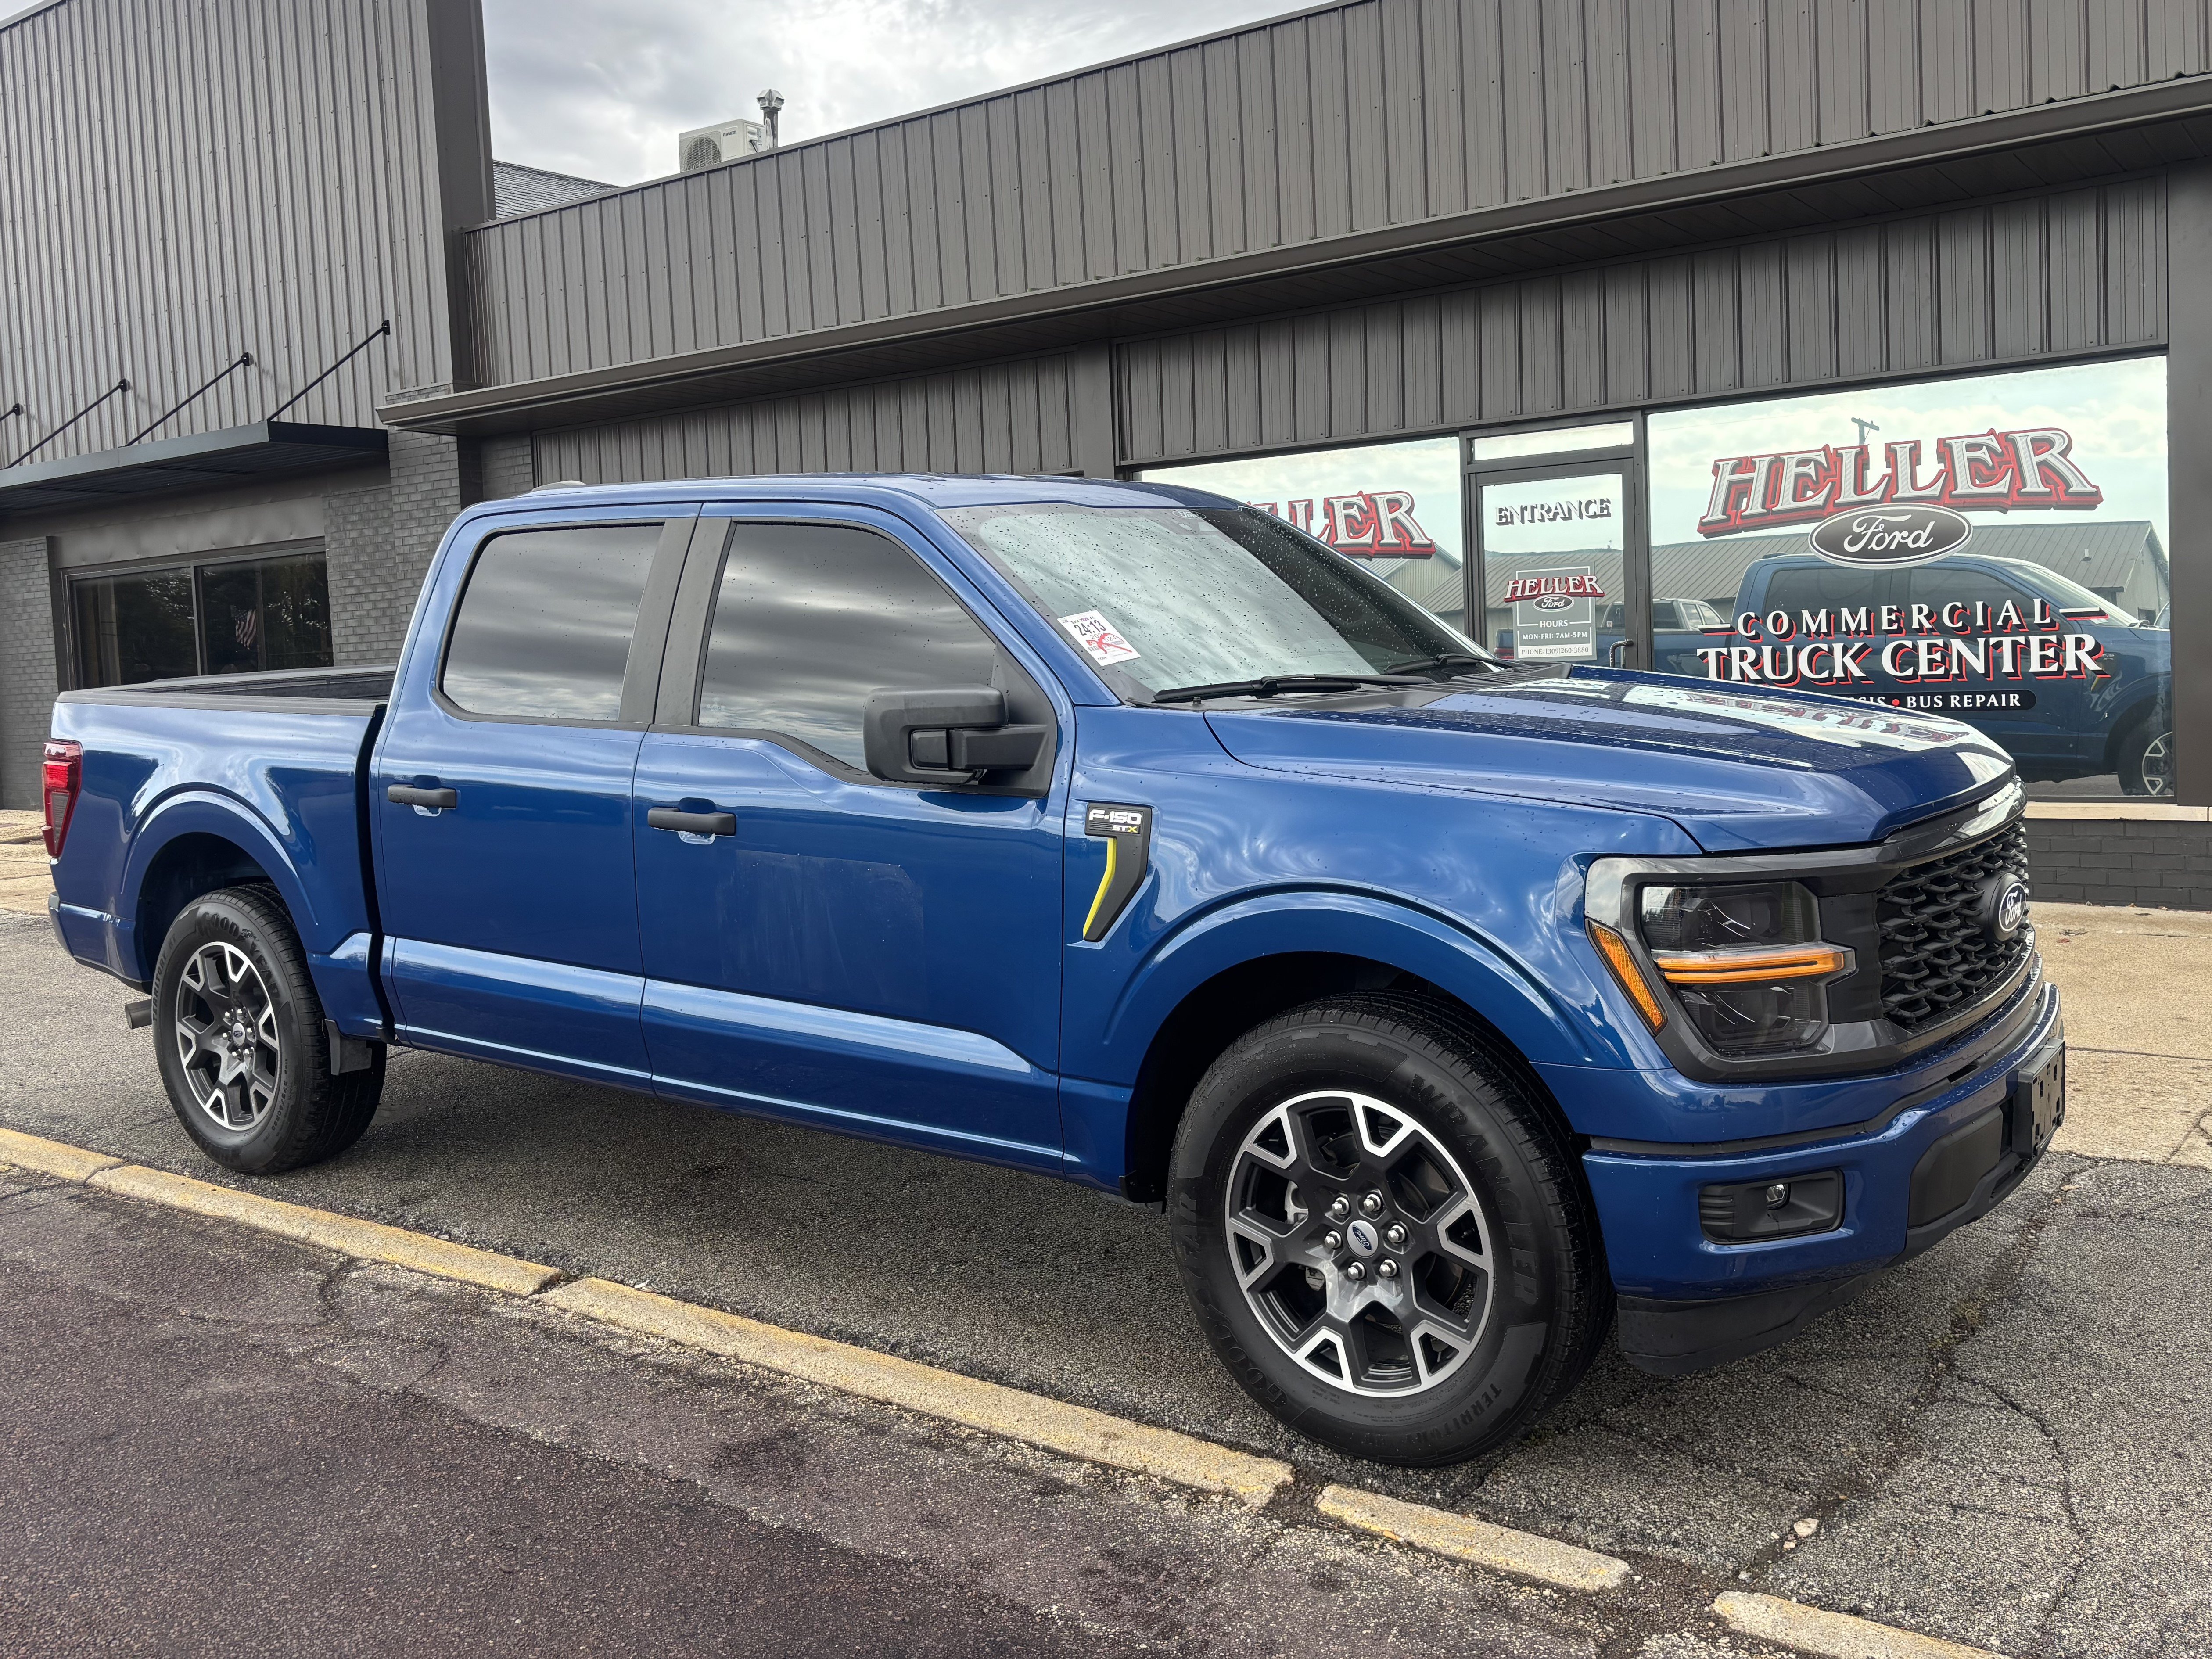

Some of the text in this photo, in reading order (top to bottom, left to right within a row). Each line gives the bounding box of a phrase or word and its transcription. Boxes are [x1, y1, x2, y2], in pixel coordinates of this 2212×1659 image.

[1698, 427, 2103, 538] HELLER
[1495, 498, 1611, 526] ENTRANCE
[1843, 514, 1933, 552] Ford
[1504, 575, 1605, 603] HELLER
[1541, 597, 1565, 608] Ford
[1738, 597, 2060, 643] COMMERCIAL
[1697, 633, 2111, 686] TRUCK CENTER
[1907, 693, 2021, 708] BUS REPAIR
[1088, 809, 1142, 825] F-150
[1112, 825, 1138, 833] STX
[2005, 890, 2022, 926] Ford
[1409, 1073, 1539, 1306] WRANGLER
[1354, 1230, 1370, 1247] Ford
